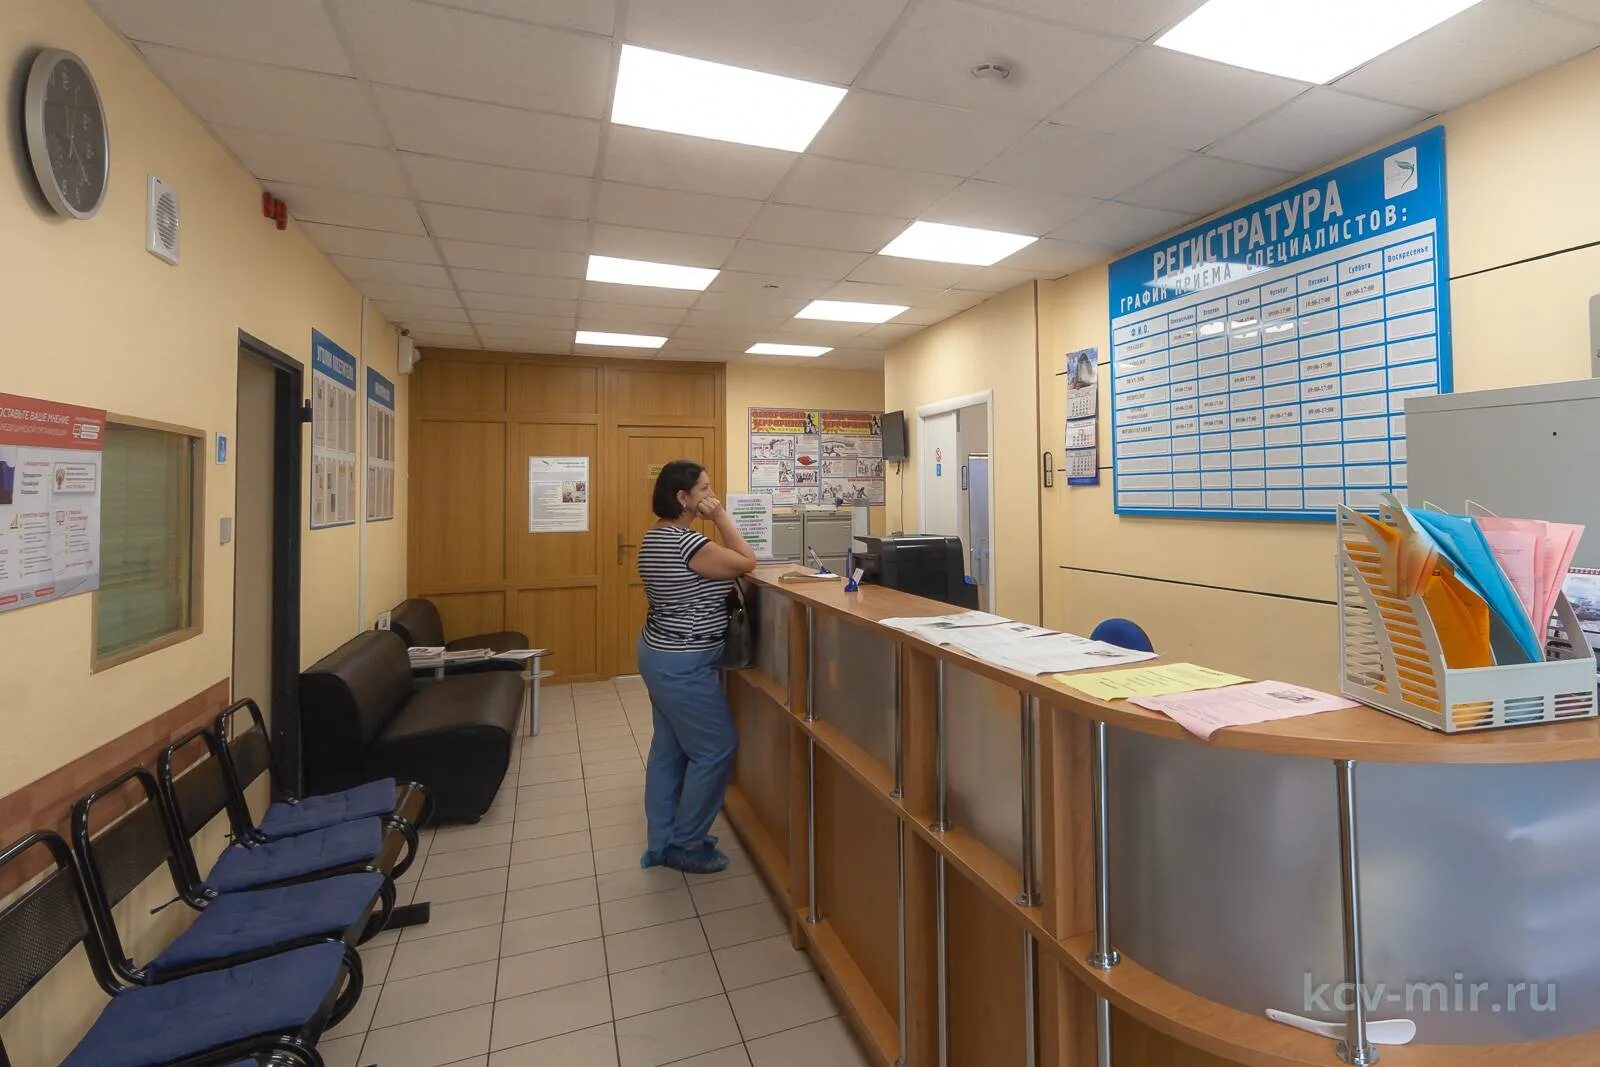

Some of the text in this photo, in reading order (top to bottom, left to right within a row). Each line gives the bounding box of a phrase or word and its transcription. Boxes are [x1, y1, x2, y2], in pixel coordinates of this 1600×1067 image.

[1120, 204, 1408, 313] ГРАФИК ПРИЕМА СПЕЦИАЛИСТОВ:
[1153, 180, 1343, 282] РЕГИСТРАТУРА
[1348, 262, 1371, 274] Суббота
[1387, 245, 1429, 263] Воскресенье
